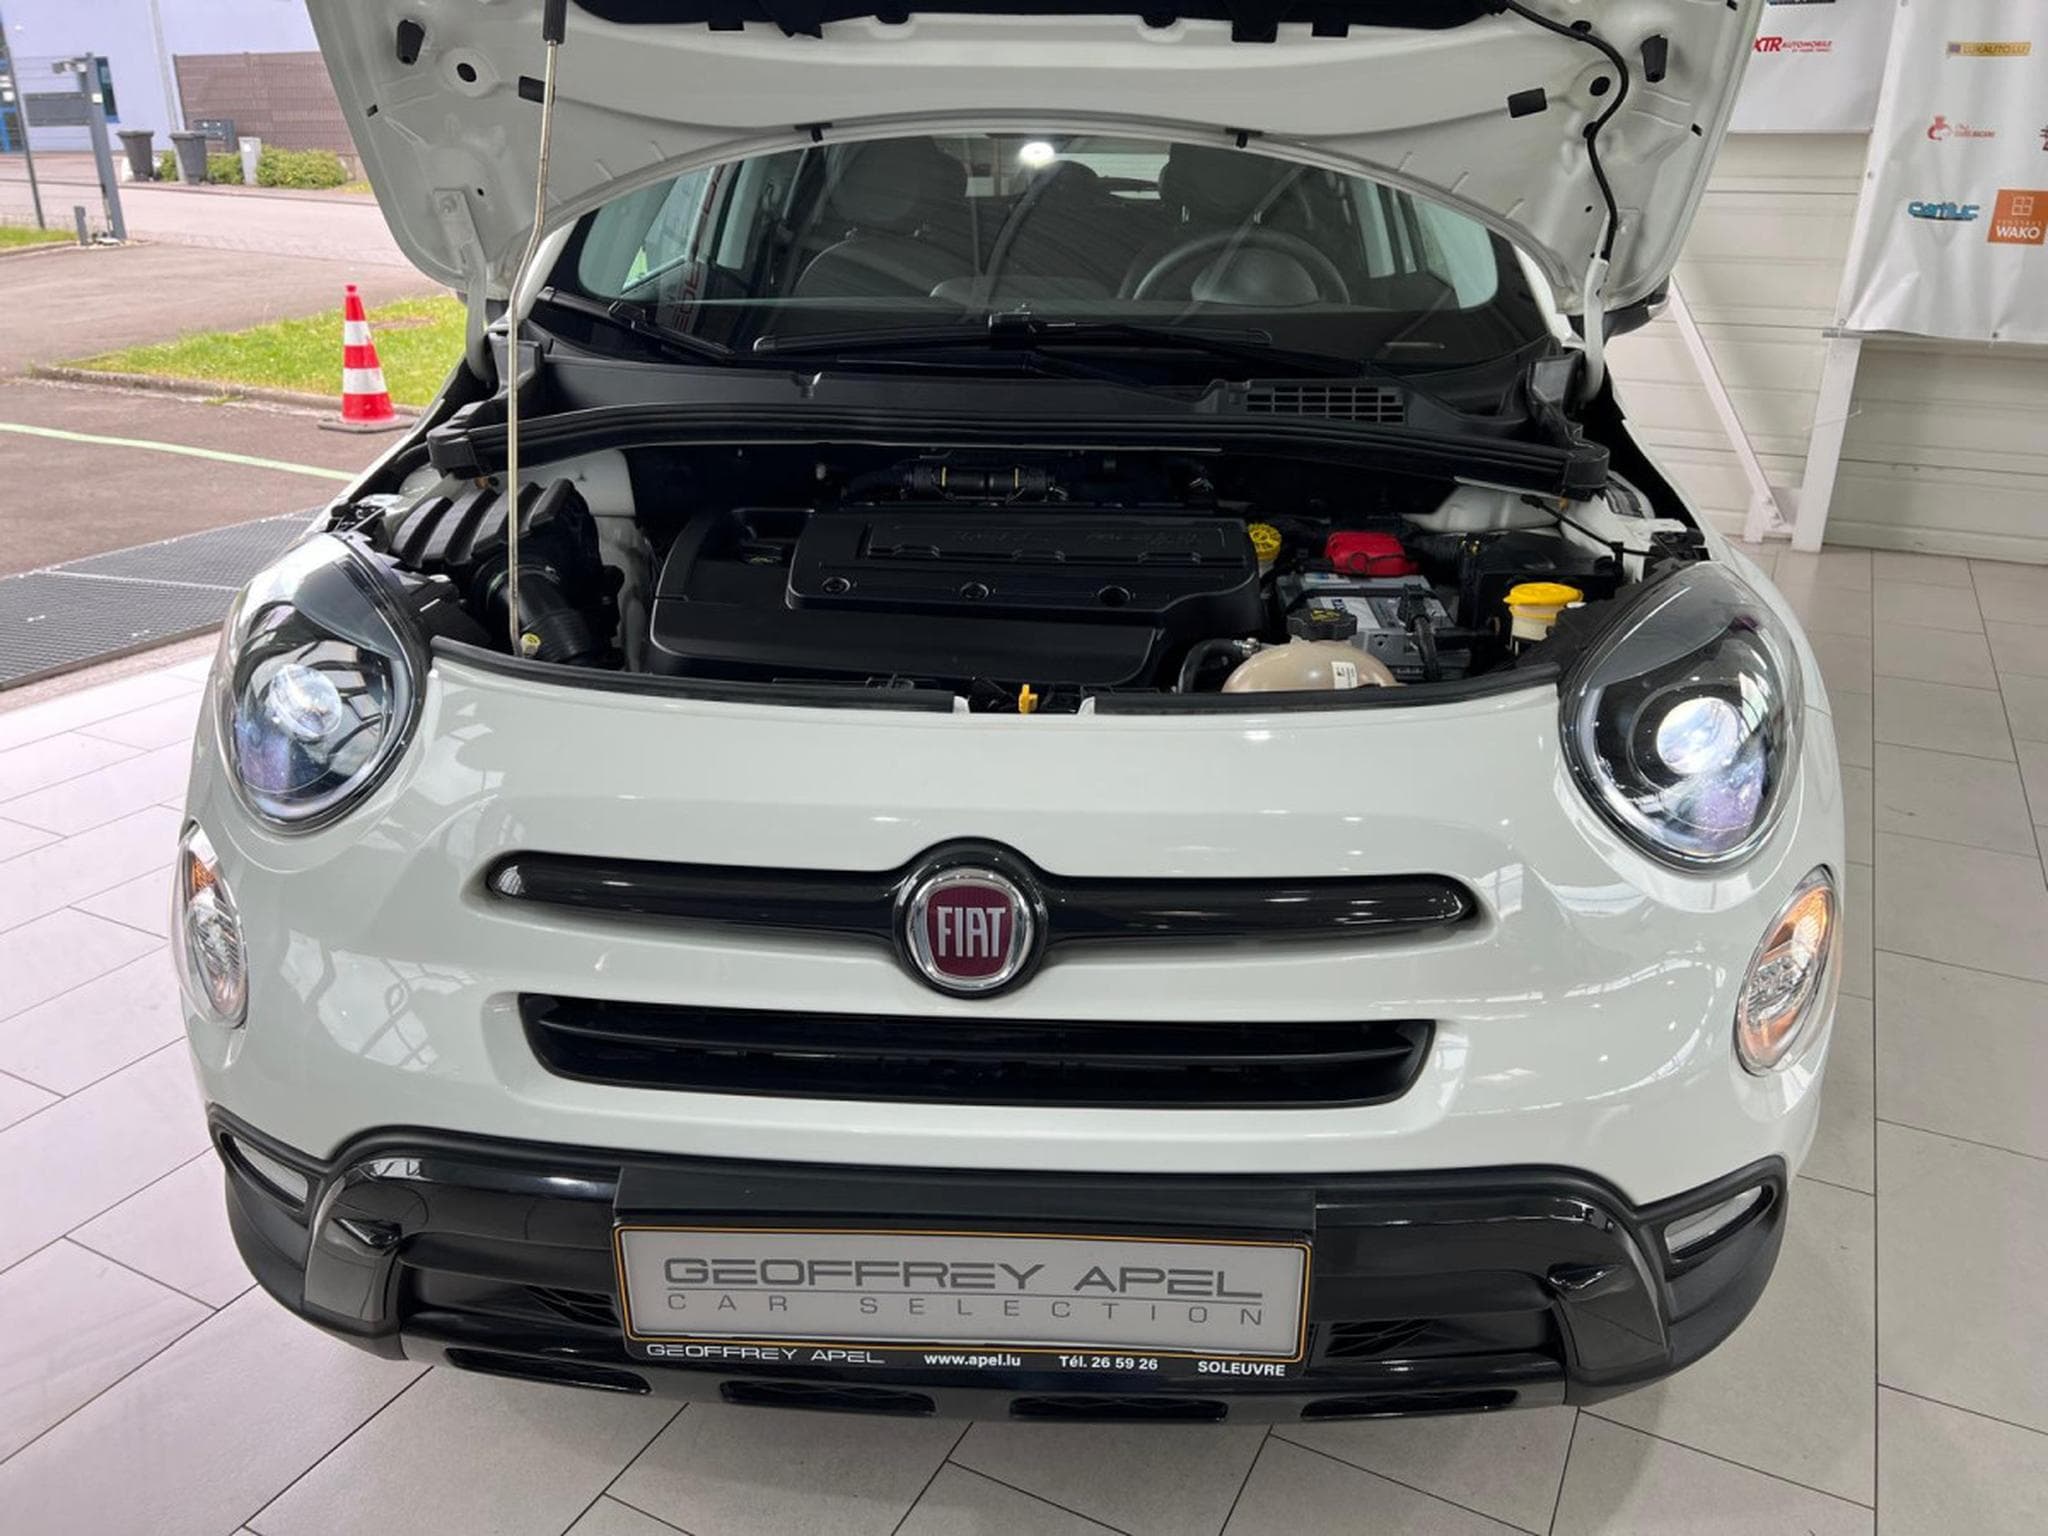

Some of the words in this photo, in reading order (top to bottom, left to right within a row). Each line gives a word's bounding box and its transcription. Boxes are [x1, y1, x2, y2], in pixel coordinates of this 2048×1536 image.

[1996, 225, 2040, 239] WAKO
[937, 906, 1006, 958] FIAT
[664, 1258, 1044, 1289] GEOFFREY
[1074, 1266, 1263, 1298] APEL
[667, 1294, 788, 1312] CAR
[859, 1296, 1262, 1326] SELECTION
[646, 1344, 798, 1361] GEOFFREY
[810, 1350, 886, 1364] APEL
[924, 1353, 1021, 1369] www.apel.lu
[1059, 1355, 1087, 1369] Tél.
[1091, 1356, 1110, 1369] 26
[1115, 1358, 1135, 1370] 59
[1138, 1358, 1158, 1371] 26
[1197, 1361, 1286, 1377] SOLEUVRE
